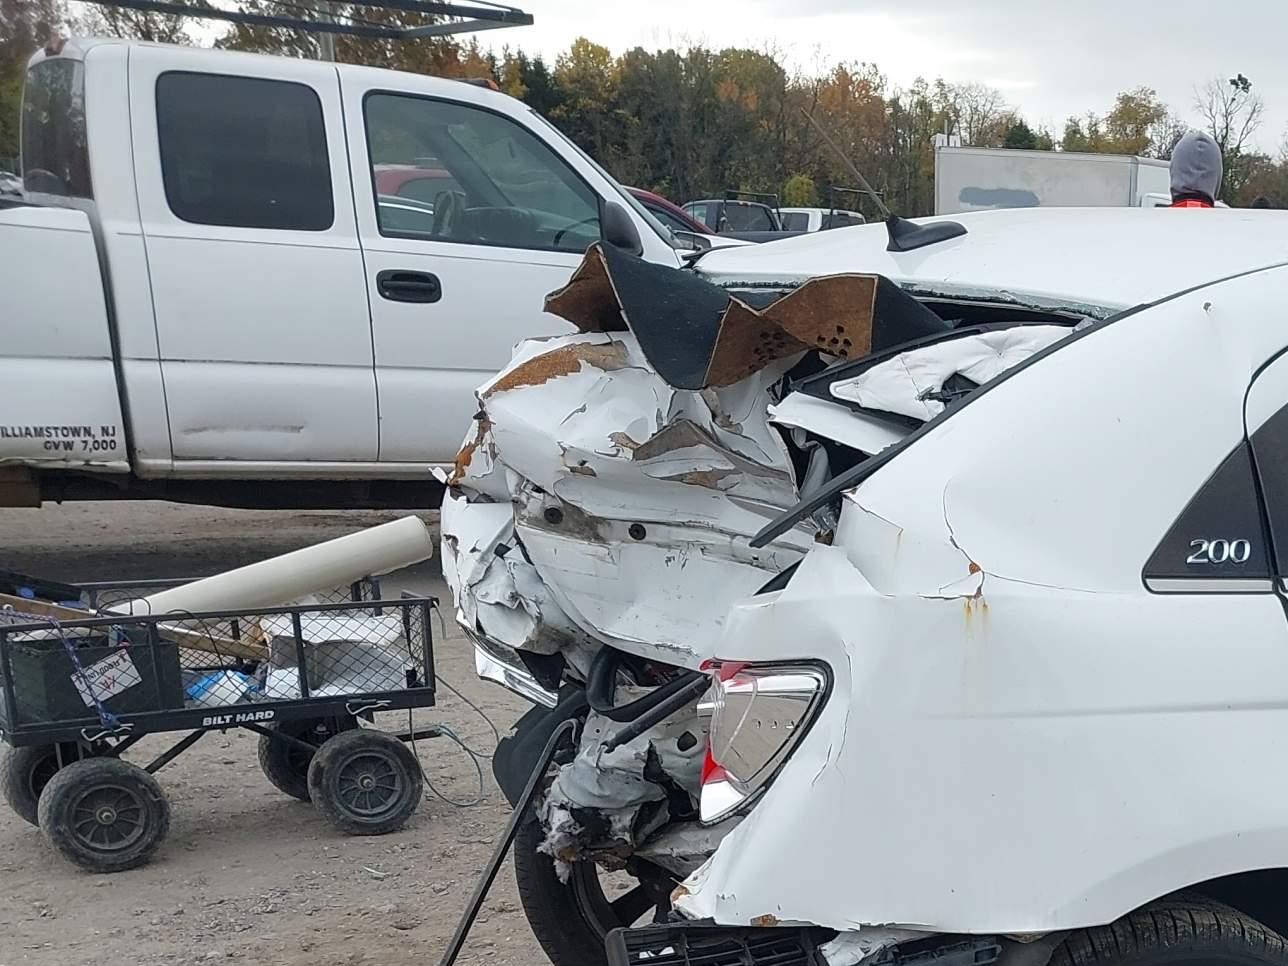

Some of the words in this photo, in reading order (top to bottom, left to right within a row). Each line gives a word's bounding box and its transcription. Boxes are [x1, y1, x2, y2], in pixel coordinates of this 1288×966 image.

[0, 426, 95, 439] ILLIAMSTOWN,
[101, 426, 116, 437] NJ
[44, 440, 74, 451] GVW
[81, 440, 117, 452] 7,000
[1186, 538, 1251, 563] 200
[202, 714, 233, 726] BILT
[235, 710, 275, 722] HARD
